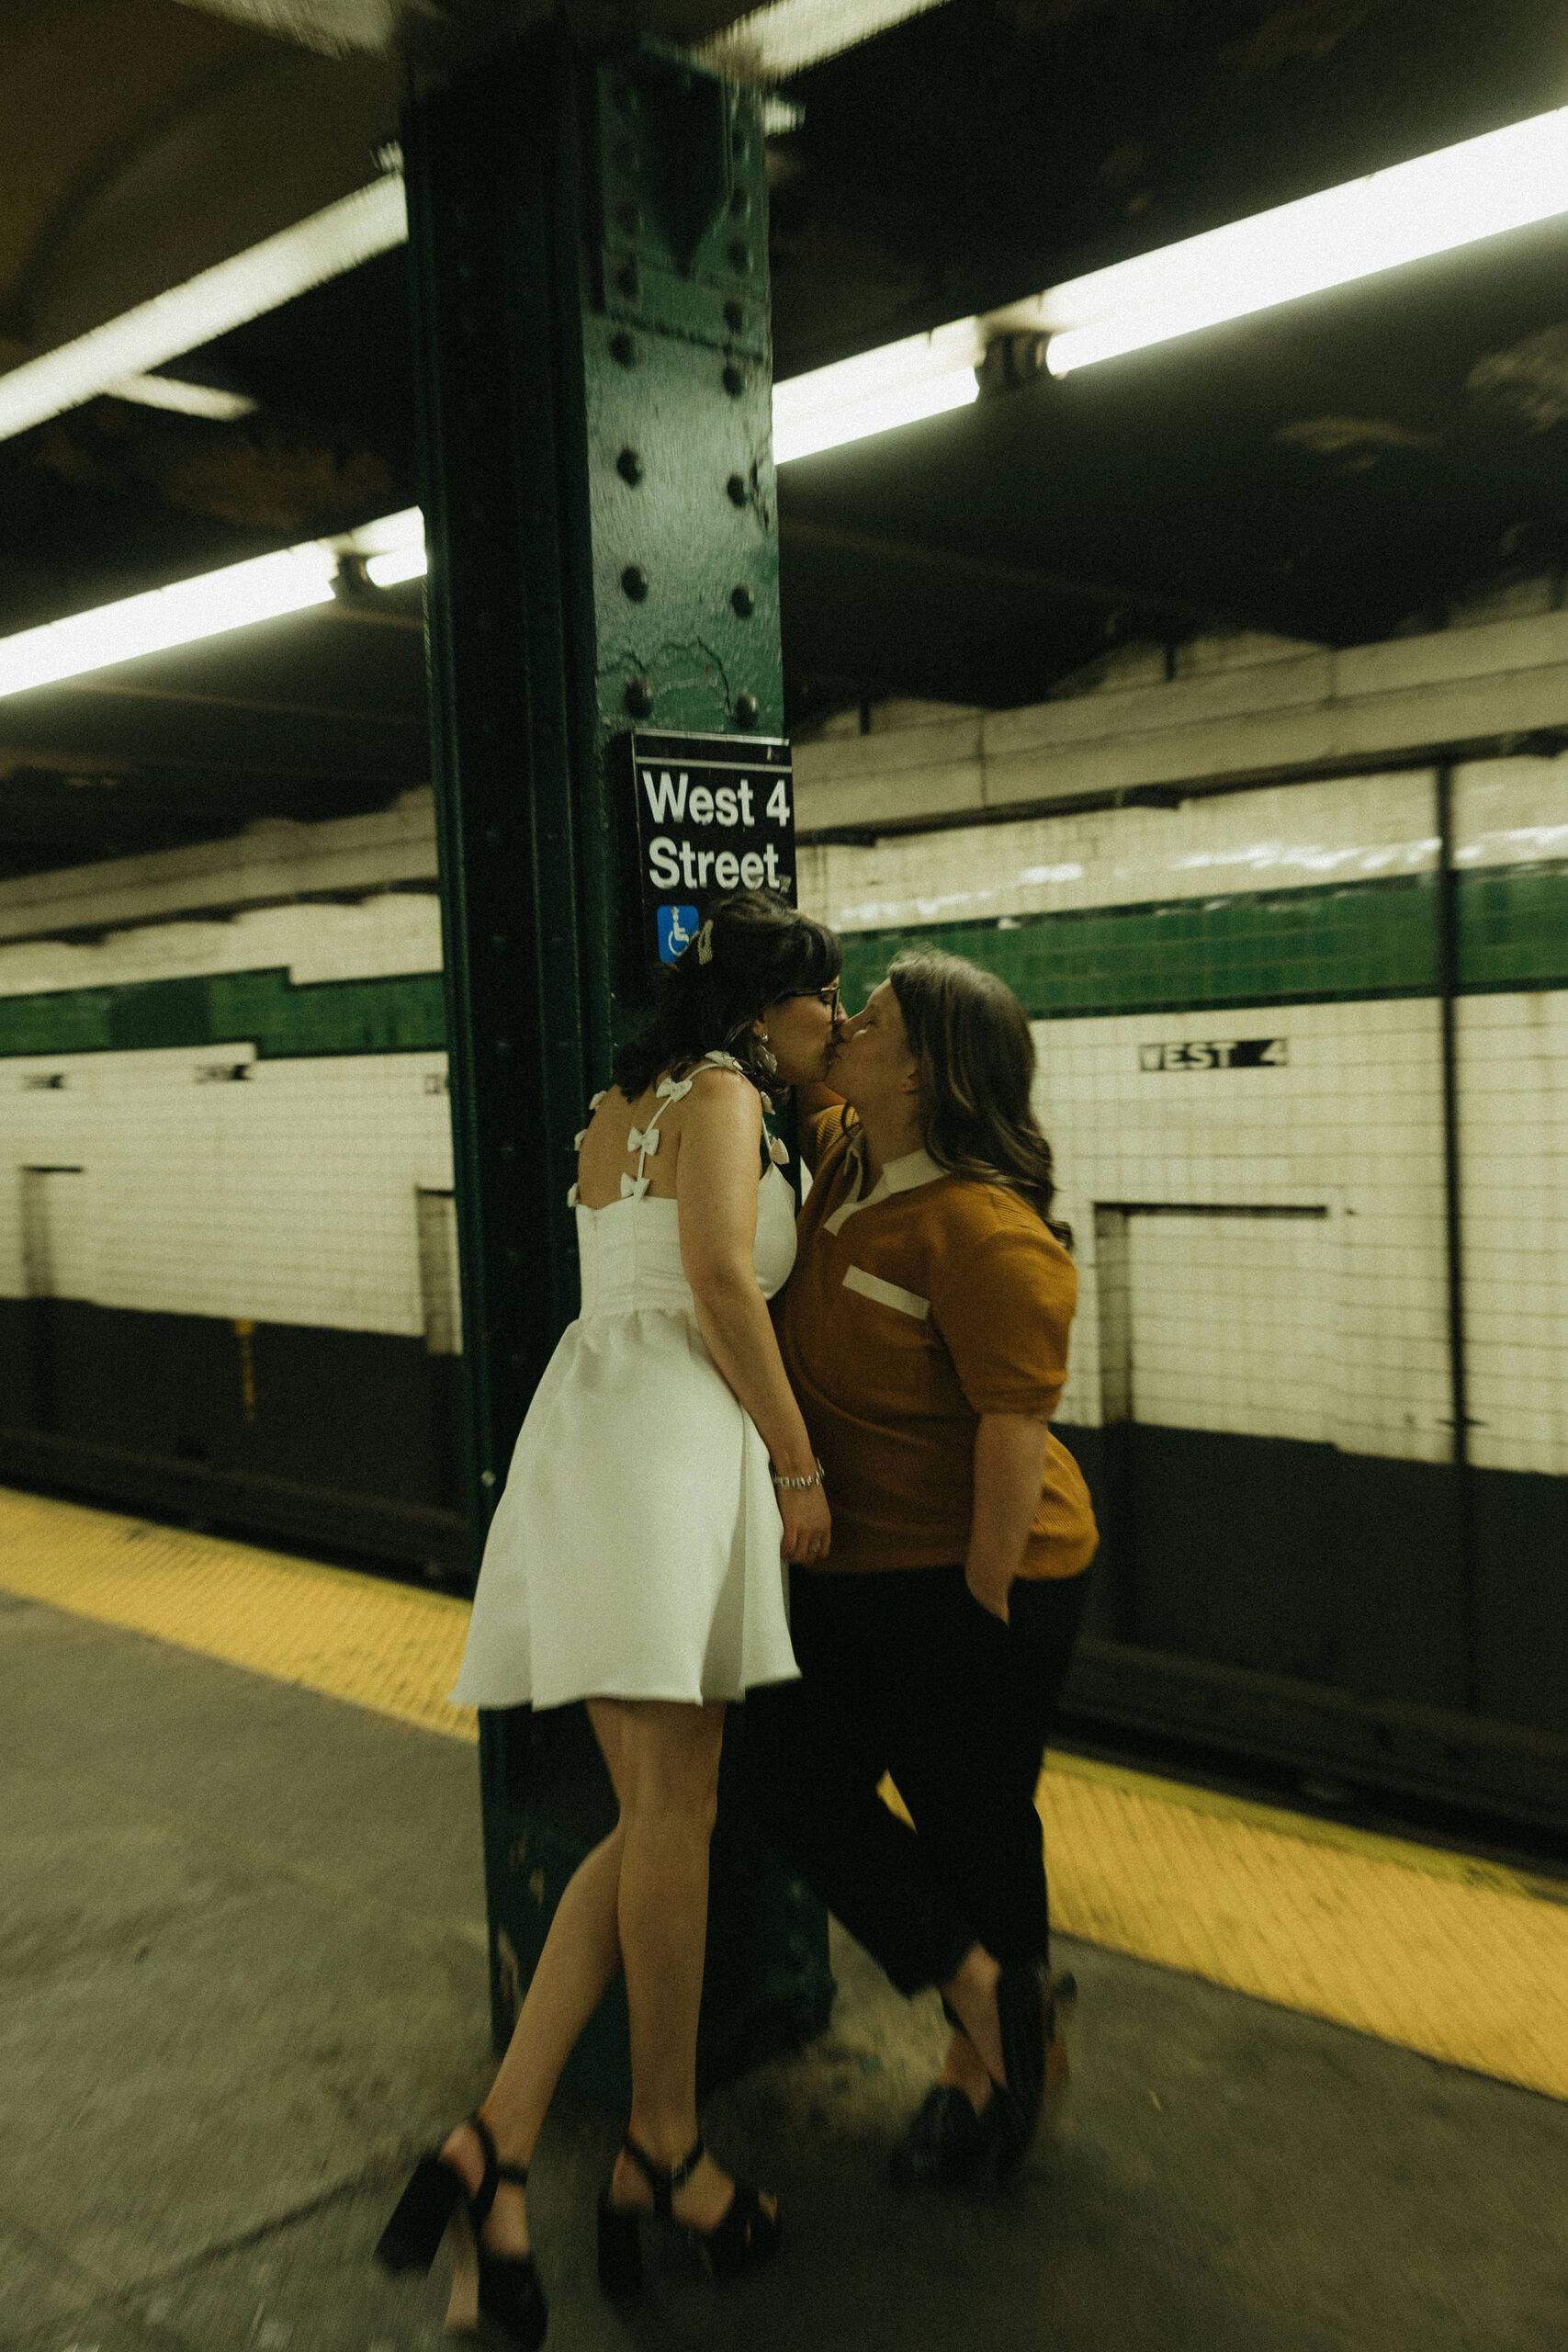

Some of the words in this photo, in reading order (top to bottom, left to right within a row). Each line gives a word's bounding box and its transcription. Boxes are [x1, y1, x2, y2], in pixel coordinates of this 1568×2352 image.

[643, 770, 755, 827] West
[766, 779, 790, 827] 4
[649, 836, 780, 889] Street
[1259, 1039, 1287, 1066] 4
